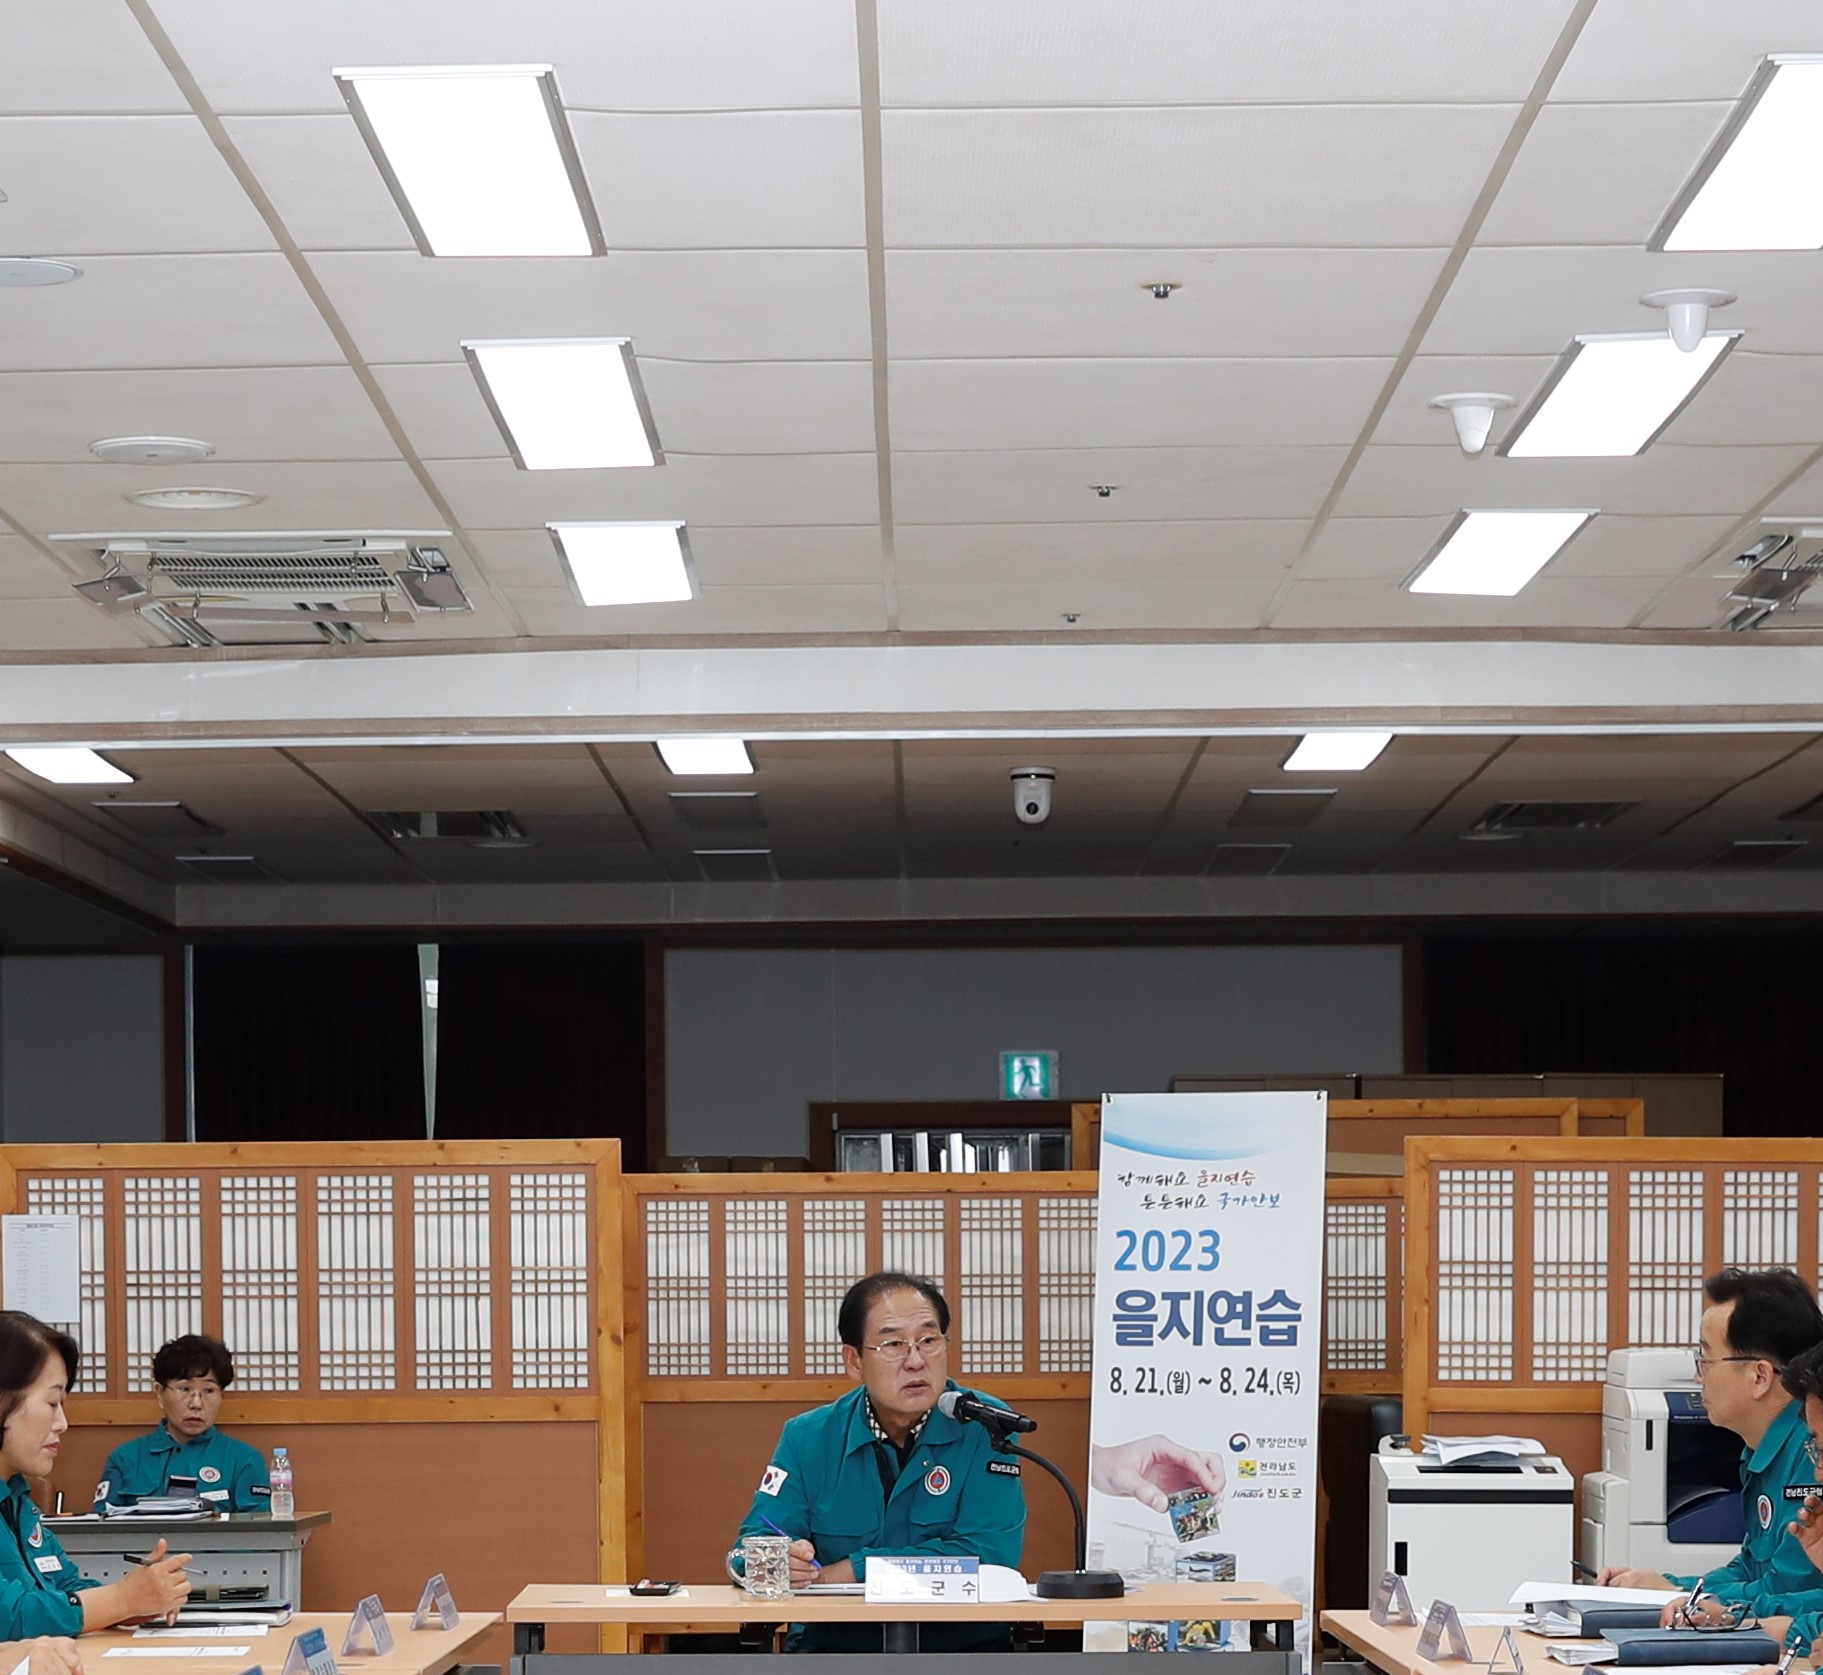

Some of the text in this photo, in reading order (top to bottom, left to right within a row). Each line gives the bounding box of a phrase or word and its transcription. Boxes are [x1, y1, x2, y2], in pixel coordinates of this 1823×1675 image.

[1196, 1169, 1256, 1188] 을지연습
[1140, 1192, 1281, 1210] 튼튼해요 국가안보
[1114, 1229, 1221, 1272] 2023
[1112, 1289, 1303, 1346] 을지연습
[1256, 1437, 1308, 1449] 행정안전부
[1259, 1462, 1297, 1472] 전라남도
[1267, 1487, 1303, 1499] 진도군
